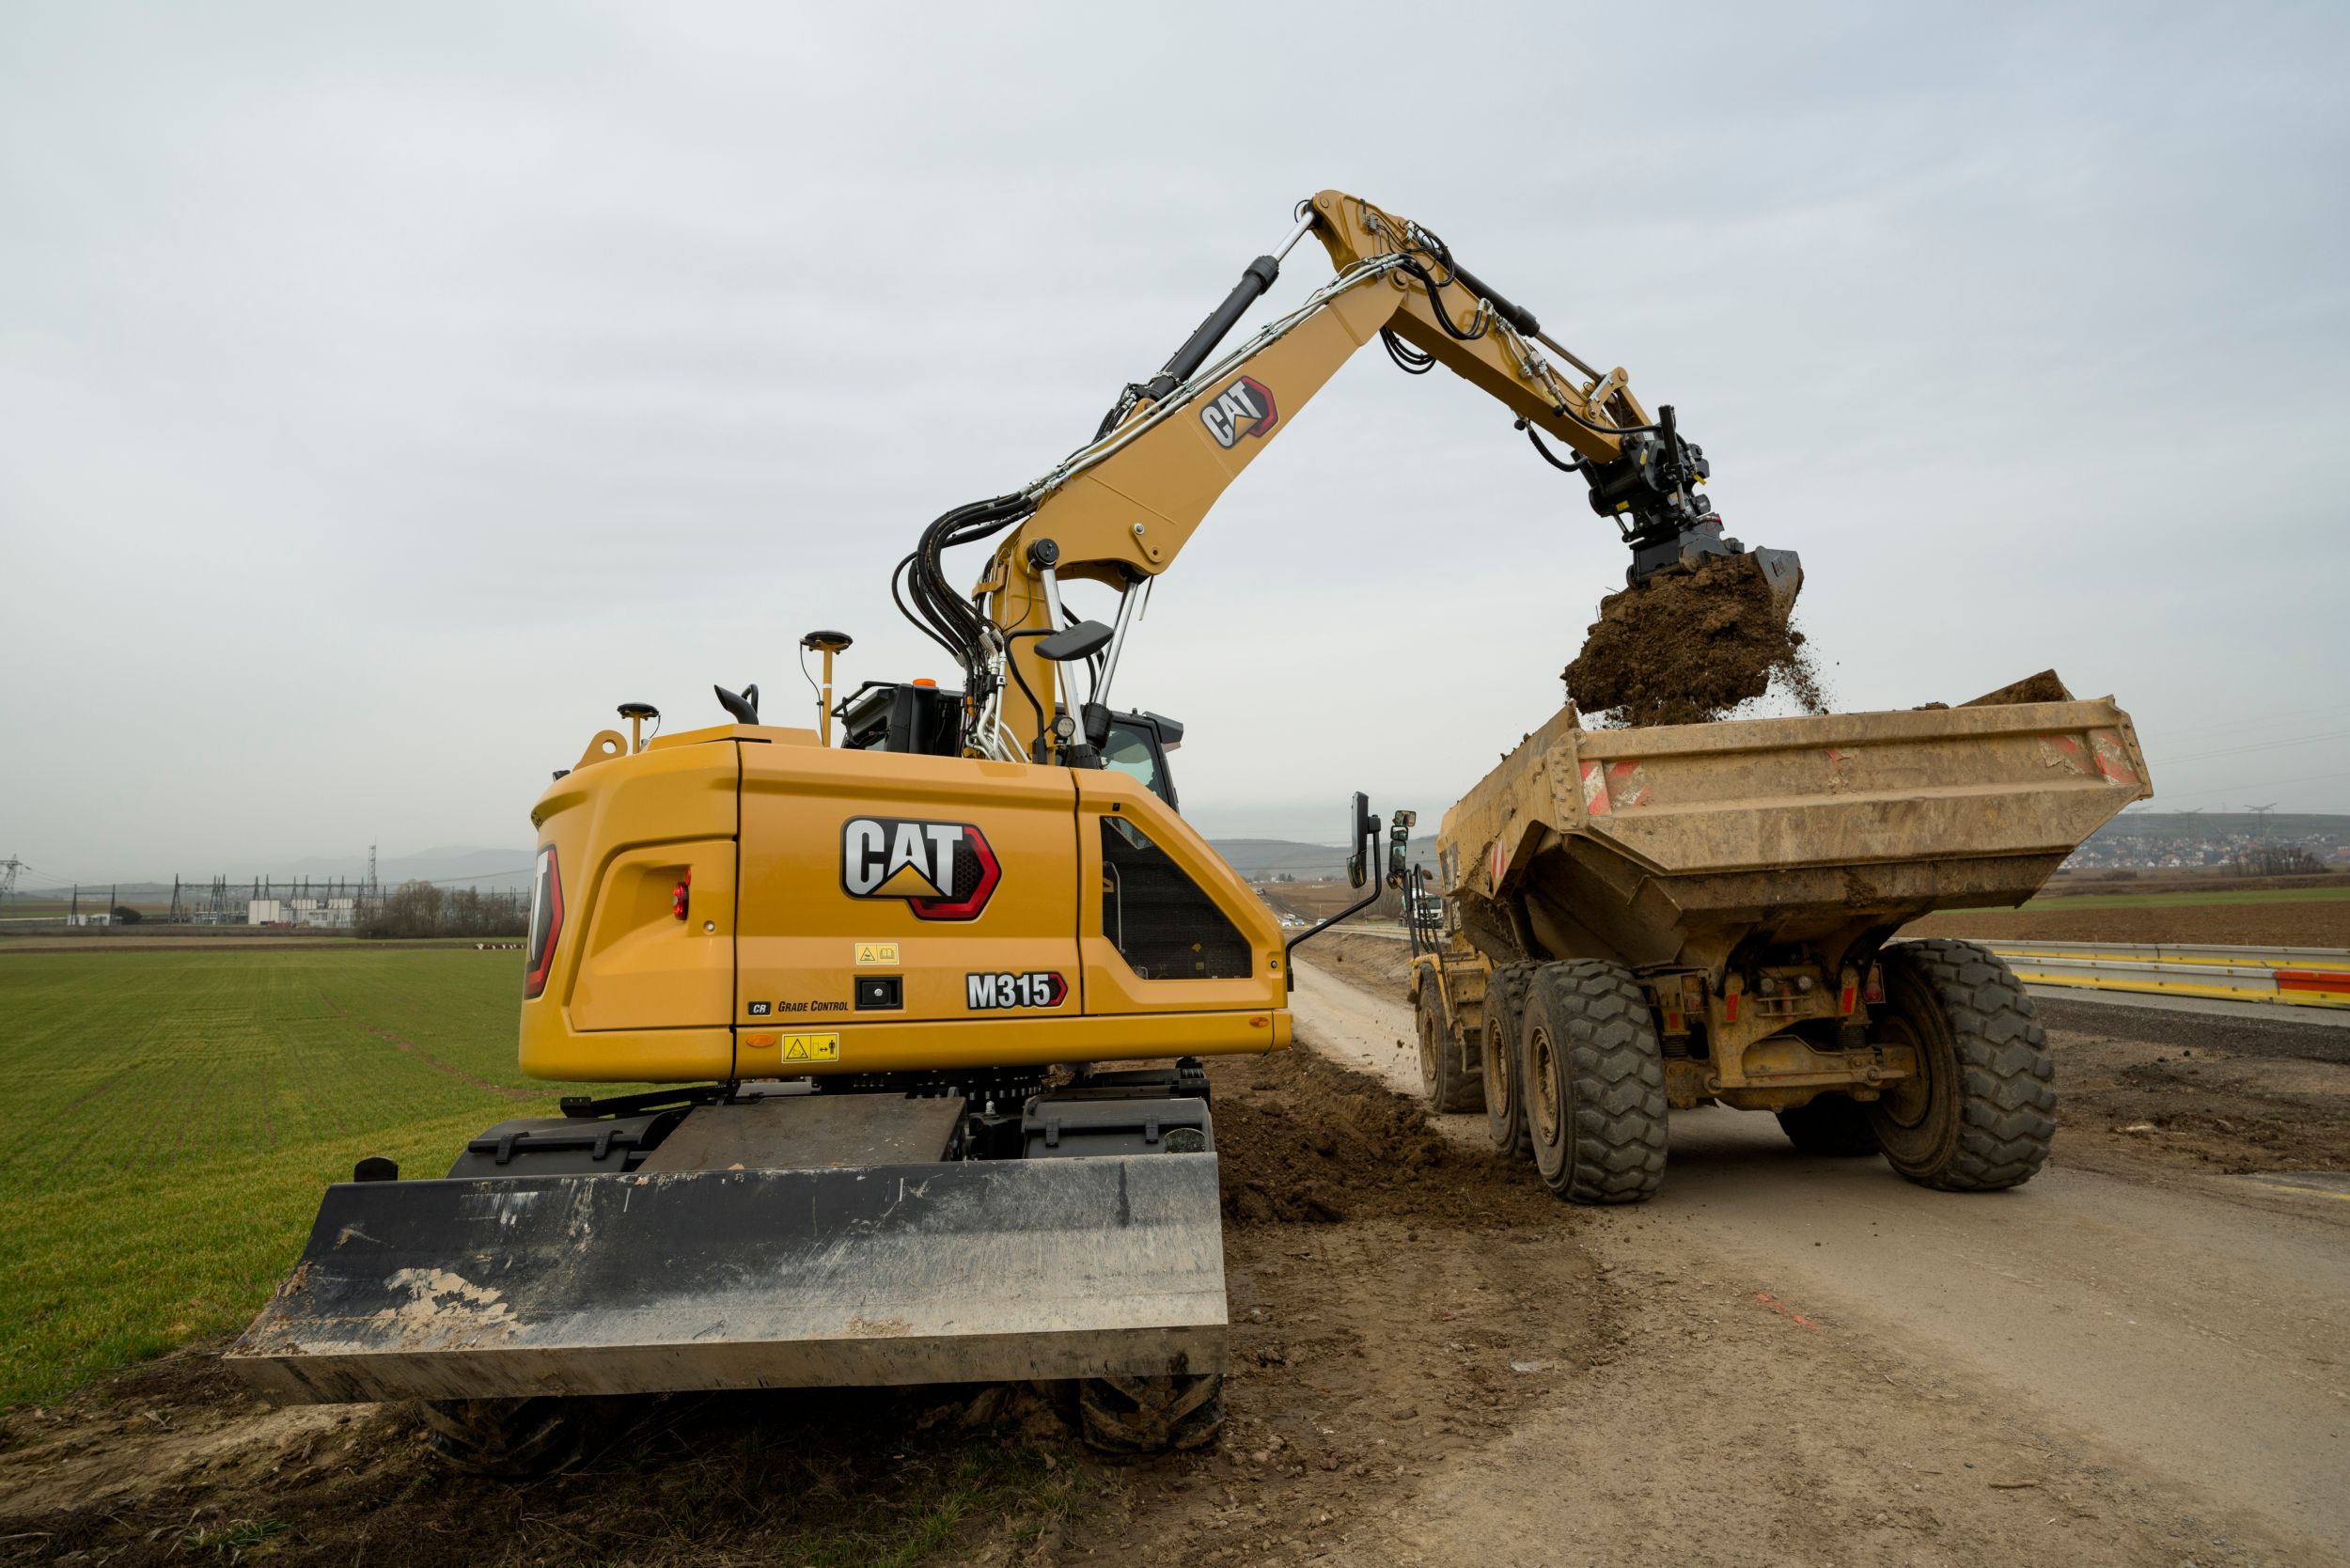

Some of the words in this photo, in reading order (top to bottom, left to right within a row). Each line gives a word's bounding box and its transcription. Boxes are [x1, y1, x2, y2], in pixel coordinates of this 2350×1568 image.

[1201, 380, 1262, 447] CAT
[845, 819, 964, 897] CAT
[753, 1004, 767, 1013] CR
[777, 1000, 809, 1012] GRADE
[810, 999, 849, 1011] CONTROL
[967, 973, 1051, 1009] M315
